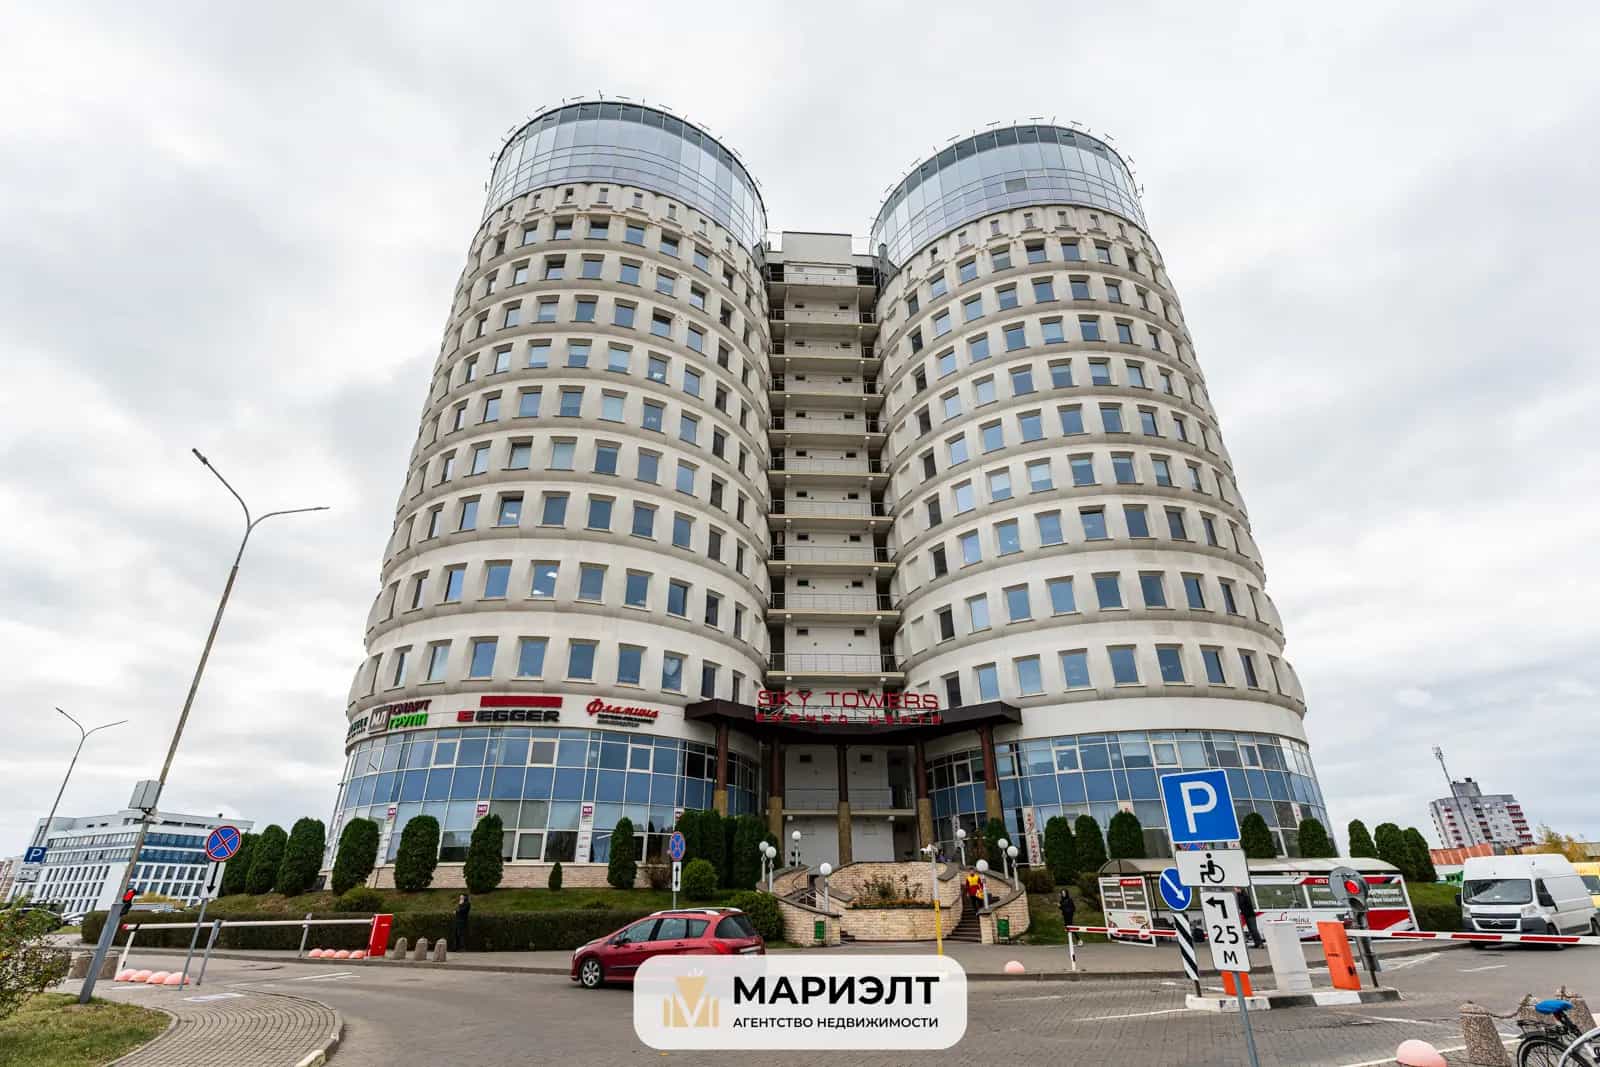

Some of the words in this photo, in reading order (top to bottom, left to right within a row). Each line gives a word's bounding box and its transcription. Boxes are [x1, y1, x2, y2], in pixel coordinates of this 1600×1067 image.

[758, 690, 813, 707] SKY
[825, 691, 939, 709] TOWERS
[389, 713, 429, 730] ГРУПП
[475, 710, 560, 723] EGGER
[1179, 781, 1217, 833] P
[29, 848, 42, 860] P
[1212, 924, 1239, 944] 25
